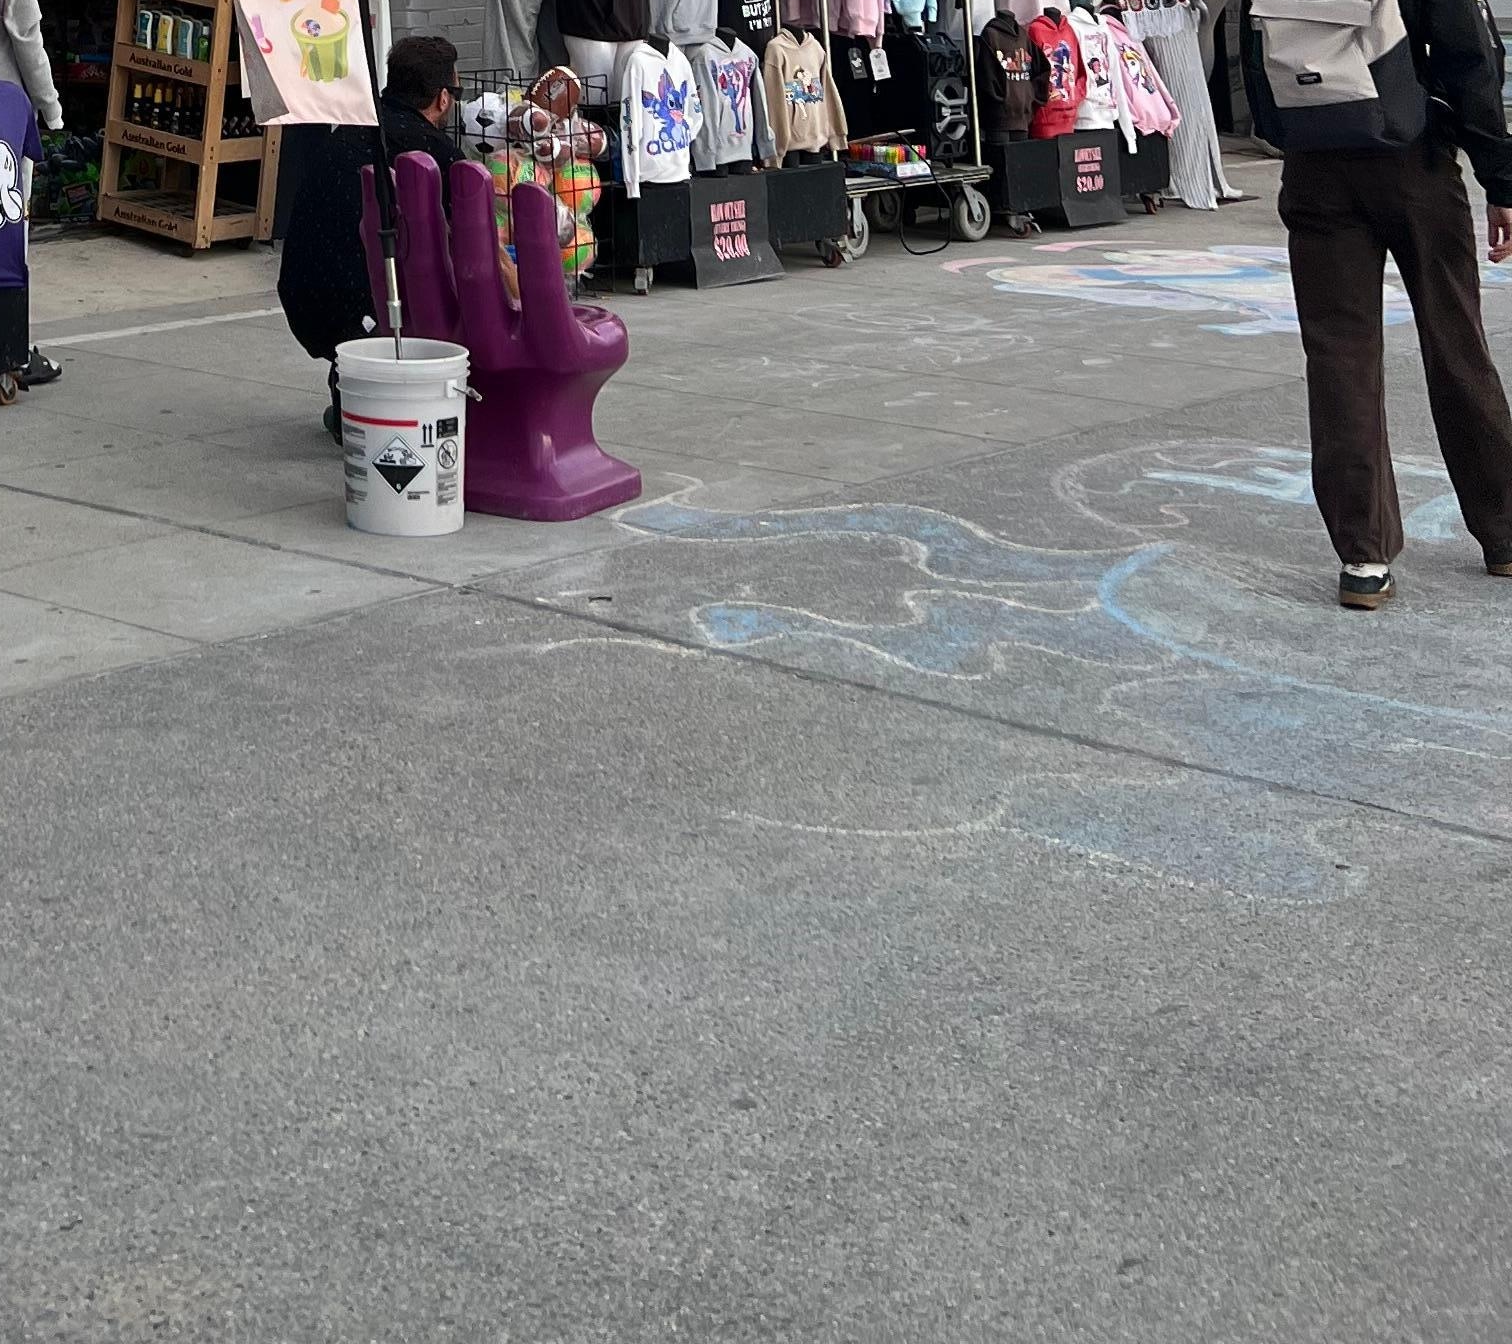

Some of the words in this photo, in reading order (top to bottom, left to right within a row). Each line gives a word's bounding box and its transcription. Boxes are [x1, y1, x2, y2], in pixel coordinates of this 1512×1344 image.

[129, 52, 173, 72] Australian
[122, 129, 165, 149] Australian
[1076, 174, 1104, 193] $20.00
[114, 206, 157, 227] Australian
